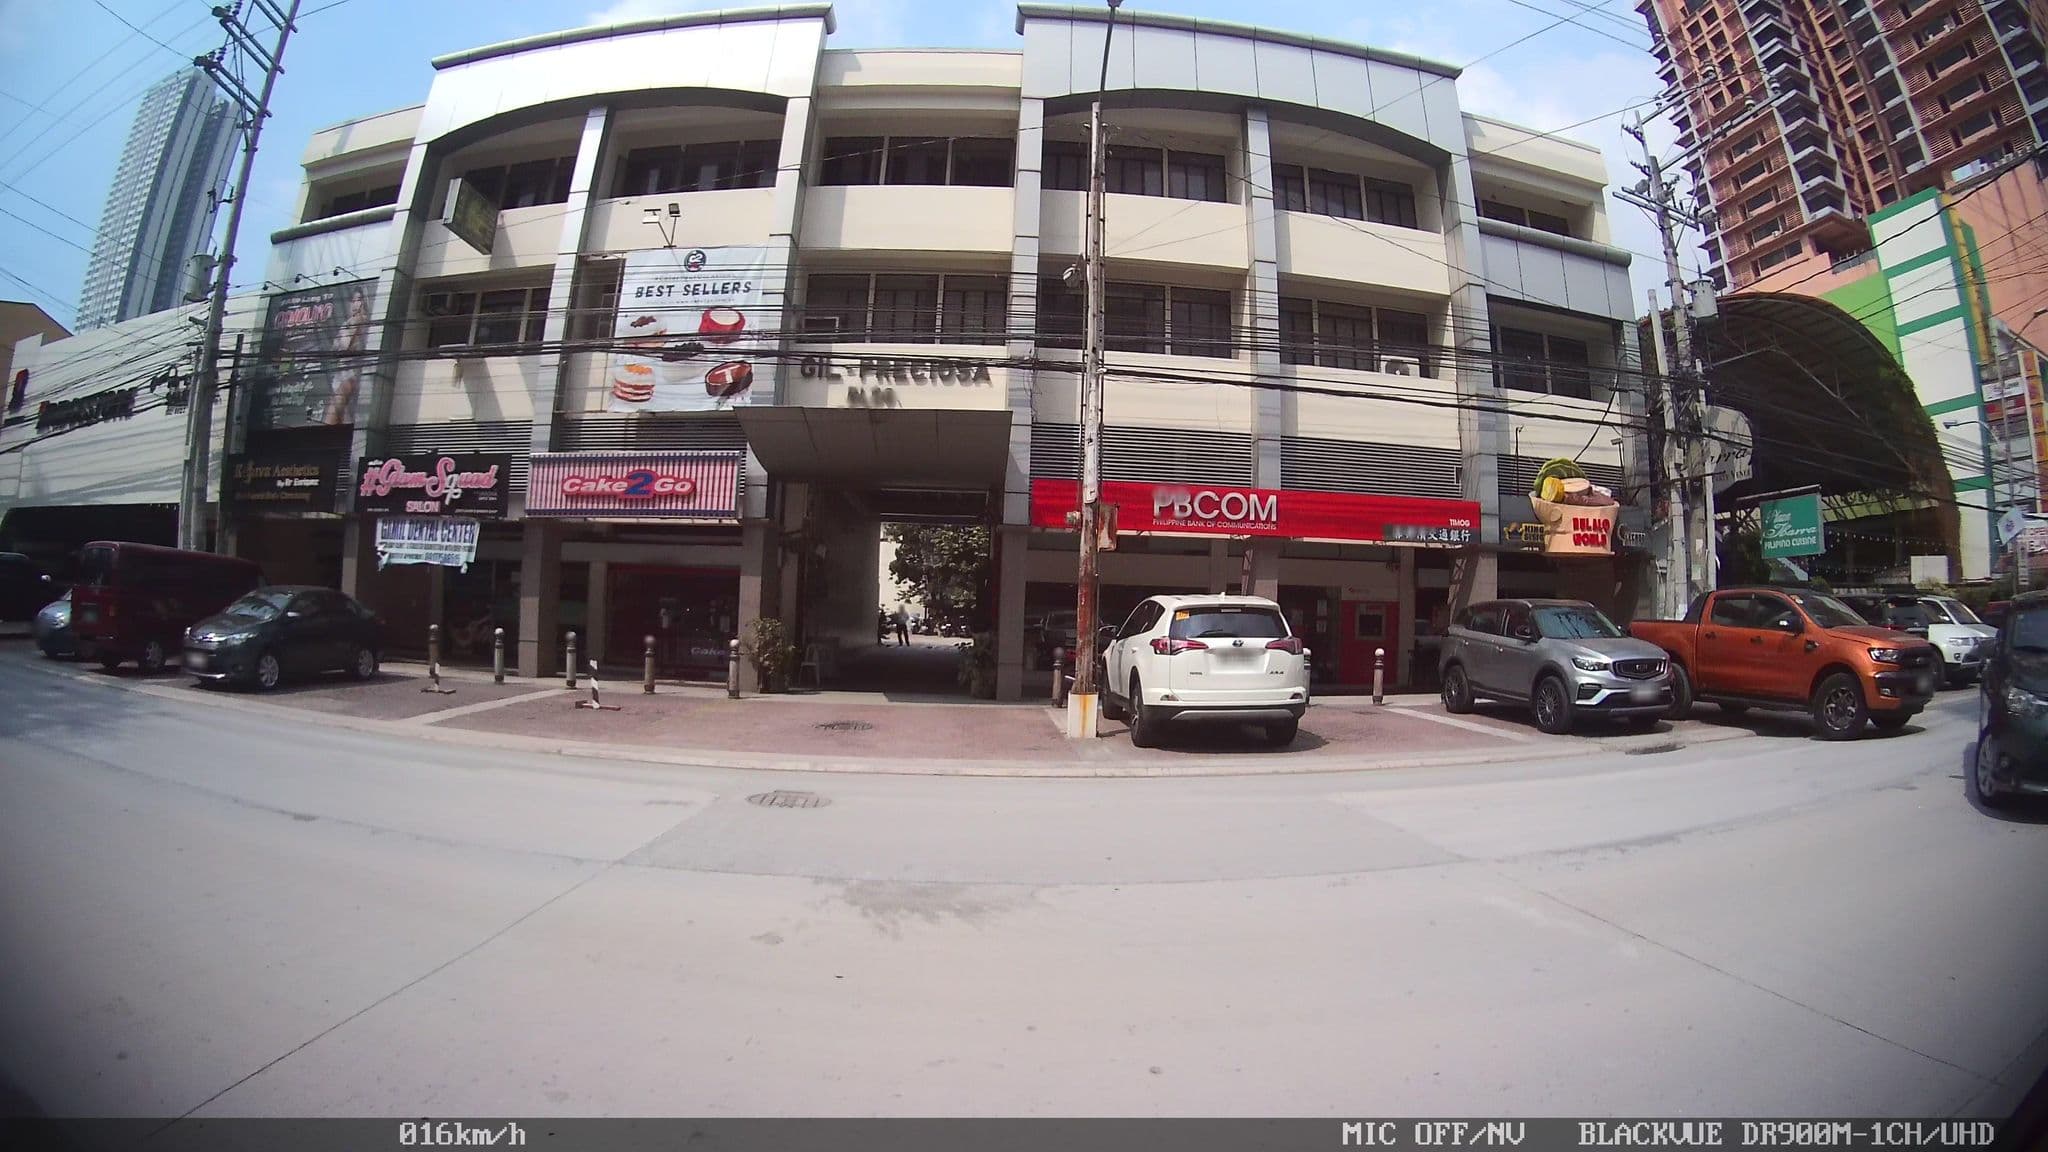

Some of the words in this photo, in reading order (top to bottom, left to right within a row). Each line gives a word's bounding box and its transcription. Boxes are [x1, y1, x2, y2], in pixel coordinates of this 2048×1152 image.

[635, 284, 675, 298] BEST
[682, 281, 752, 296] SELLERS
[405, 500, 441, 512] SALON
[1153, 488, 1277, 522] PBCOM
[1153, 519, 1187, 527] PHILIPPINE
[1217, 521, 1277, 530] COMMUNICATIONS
[1449, 518, 1471, 527] TIMOG
[441, 521, 475, 544] CENTER
